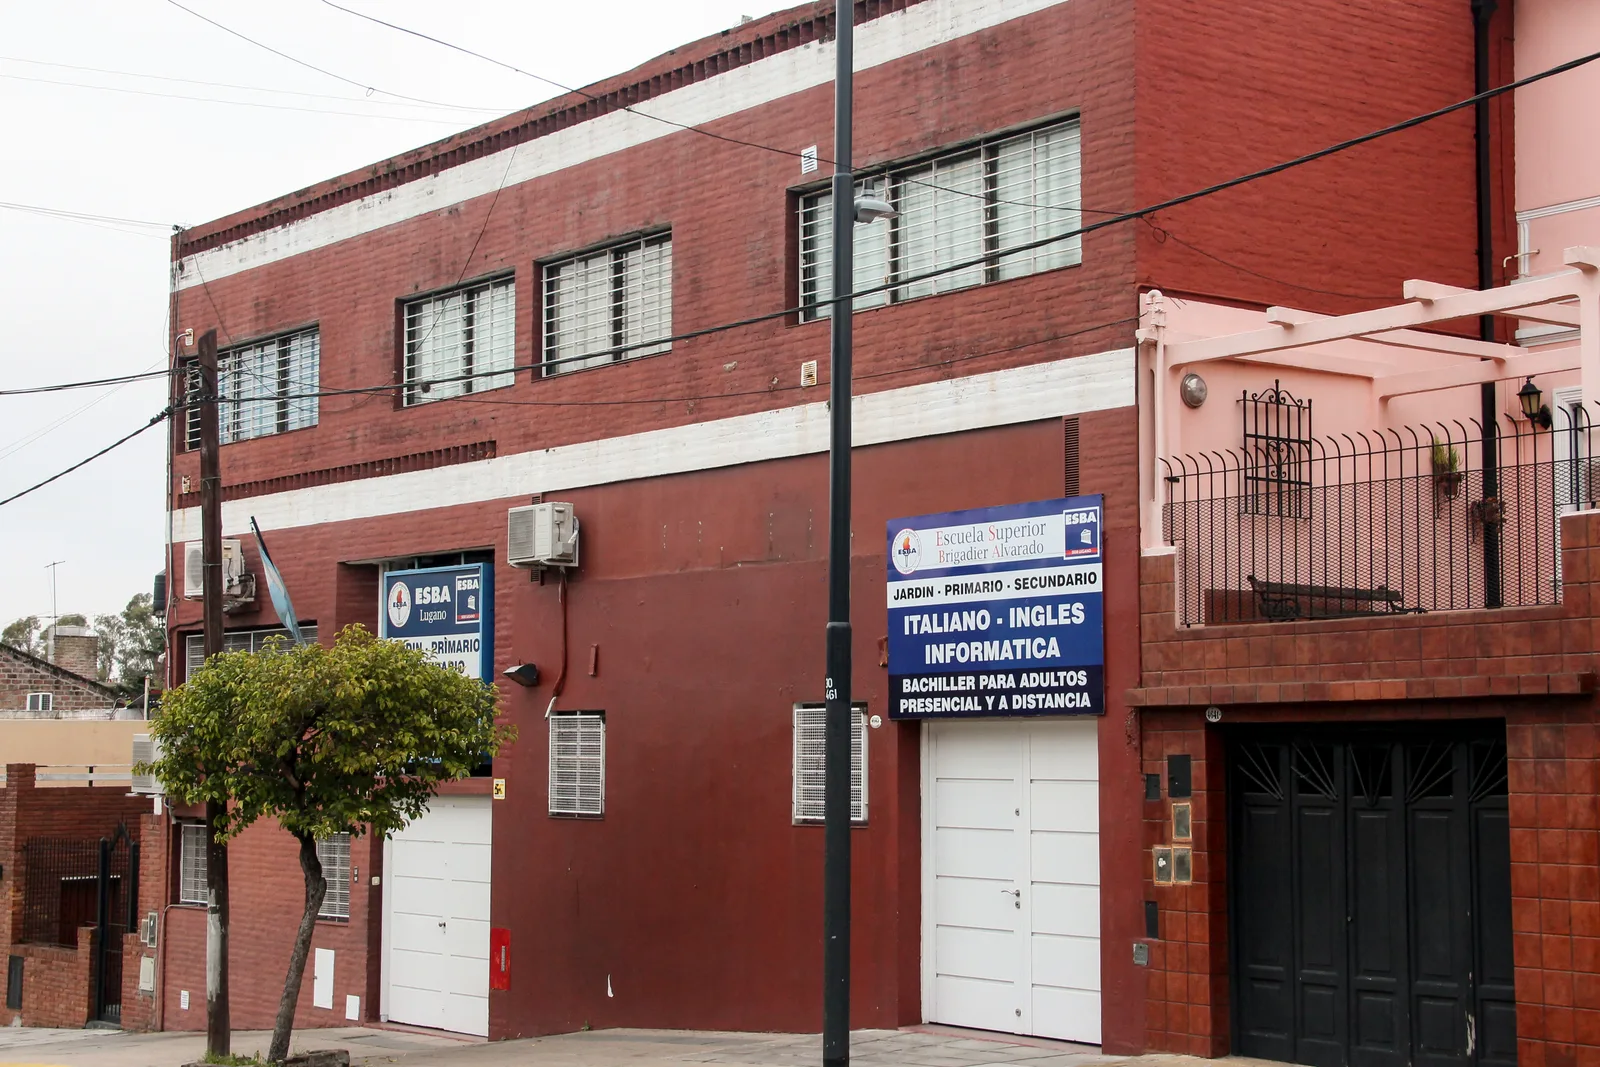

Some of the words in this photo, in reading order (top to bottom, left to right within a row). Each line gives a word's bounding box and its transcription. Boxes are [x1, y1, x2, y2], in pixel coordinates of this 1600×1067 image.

[1065, 511, 1097, 525] ESBA
[936, 526, 984, 546] Escuela
[988, 522, 1047, 544] Superior
[938, 548, 989, 565] Brigadier
[992, 541, 1044, 558] Alvarado
[415, 586, 451, 605] ESBA
[457, 579, 479, 591] ESBA
[893, 586, 934, 600] JARDIN
[944, 580, 1003, 596] PRIMARIO
[1014, 572, 1097, 591] SECUNDARIO
[420, 609, 447, 623] Lugano
[904, 609, 991, 635] ITALIANO
[1009, 602, 1085, 628] INGLES
[925, 637, 1061, 664] INFORMATICA
[902, 676, 975, 693] BACHILLER
[979, 673, 1016, 690] PARA
[1019, 670, 1088, 688] ADULTOS
[900, 697, 982, 713] PRESENCIAL
[985, 695, 996, 710] Y
[998, 695, 1009, 710] A
[1012, 692, 1091, 710] DISTANCIA
